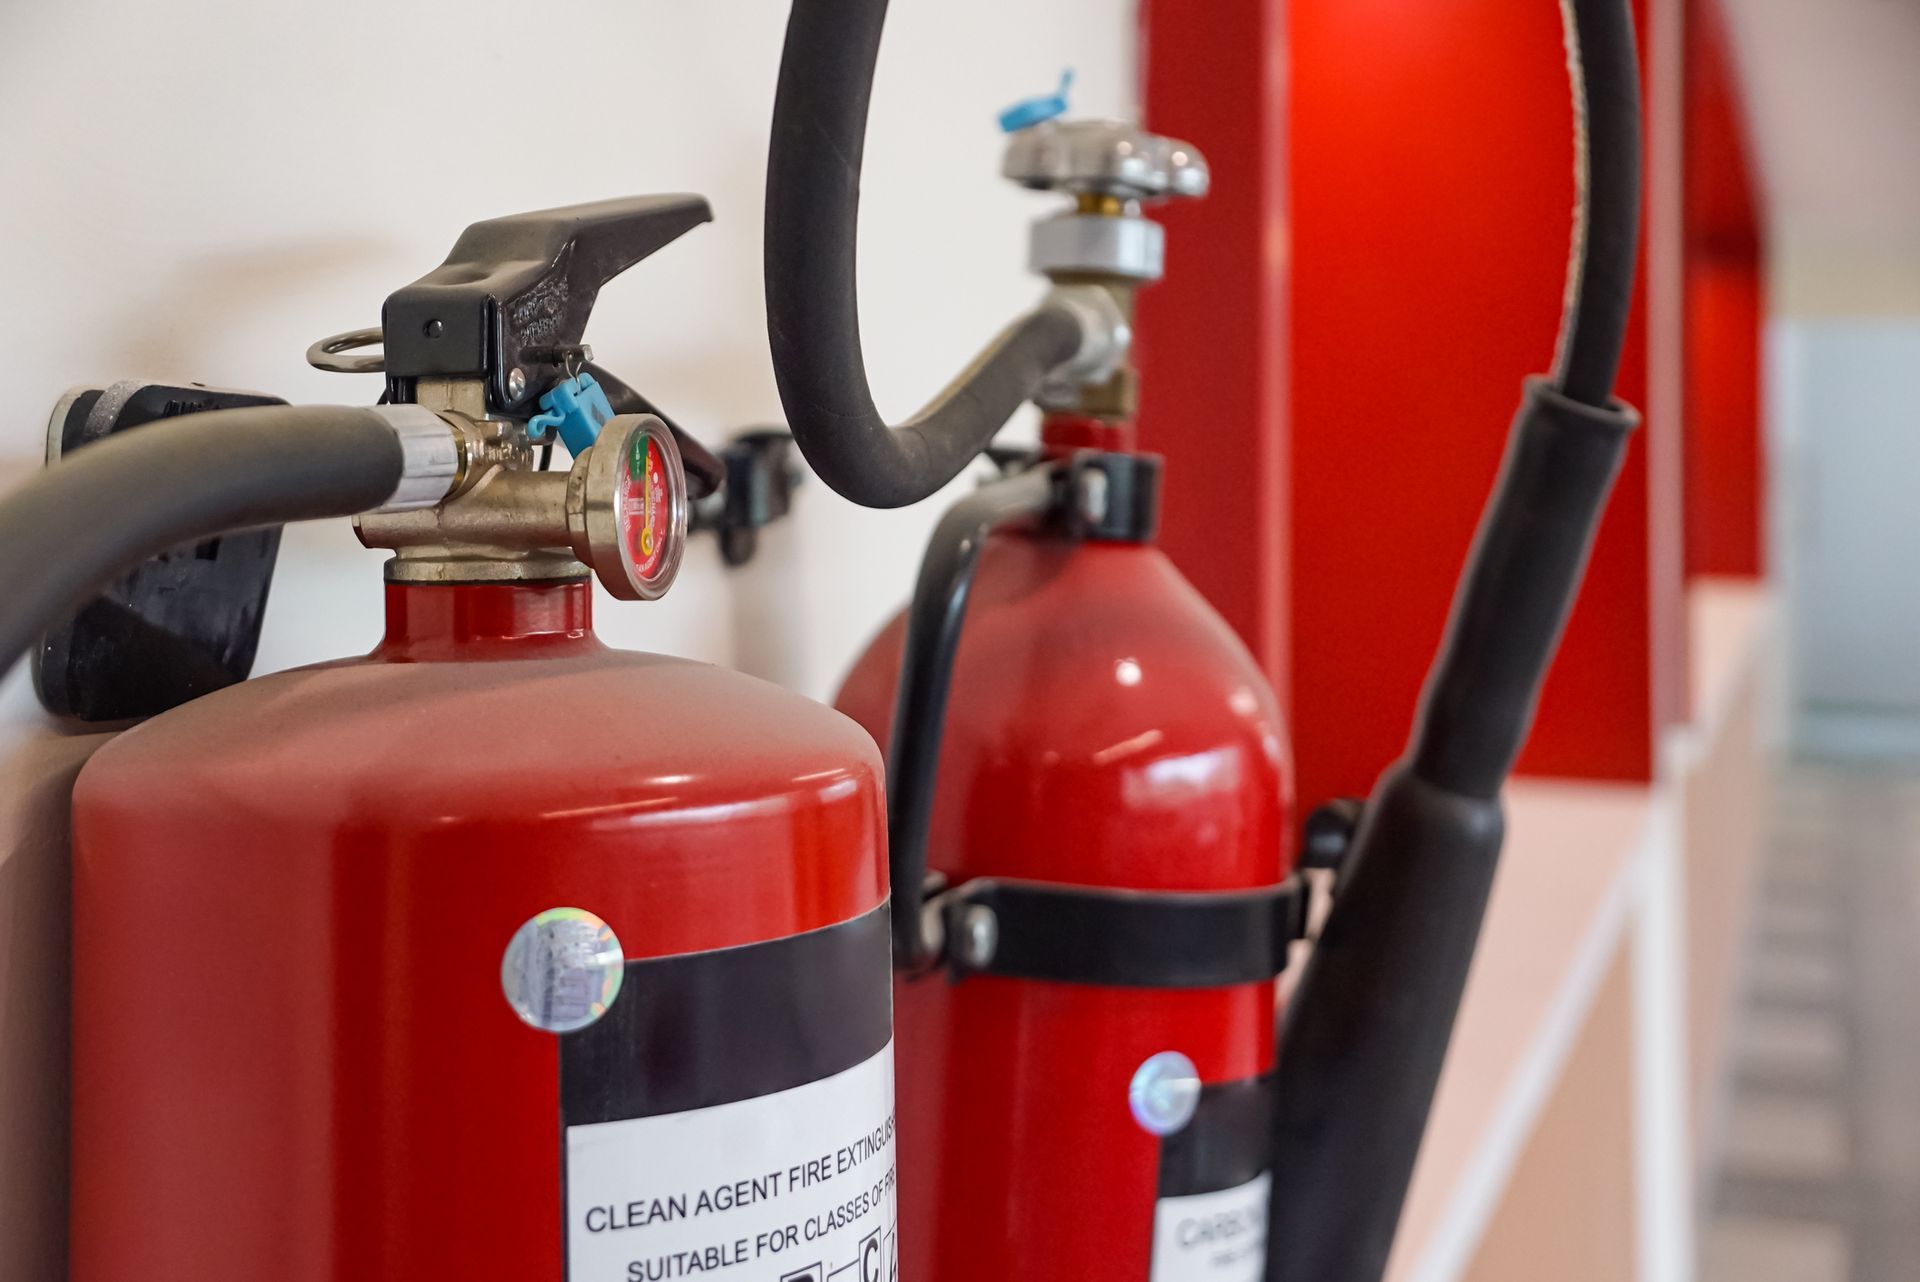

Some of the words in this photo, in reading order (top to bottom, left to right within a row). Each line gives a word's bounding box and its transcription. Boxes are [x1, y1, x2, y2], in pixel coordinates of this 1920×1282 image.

[586, 1193, 687, 1233] CLEAN
[694, 1171, 782, 1216] AGENT
[789, 1154, 832, 1192] FIRE
[627, 1238, 749, 1282] SUITABLE
[756, 1224, 799, 1258] FOR
[804, 1191, 869, 1241] CLASSES
[872, 1179, 883, 1207] OF
